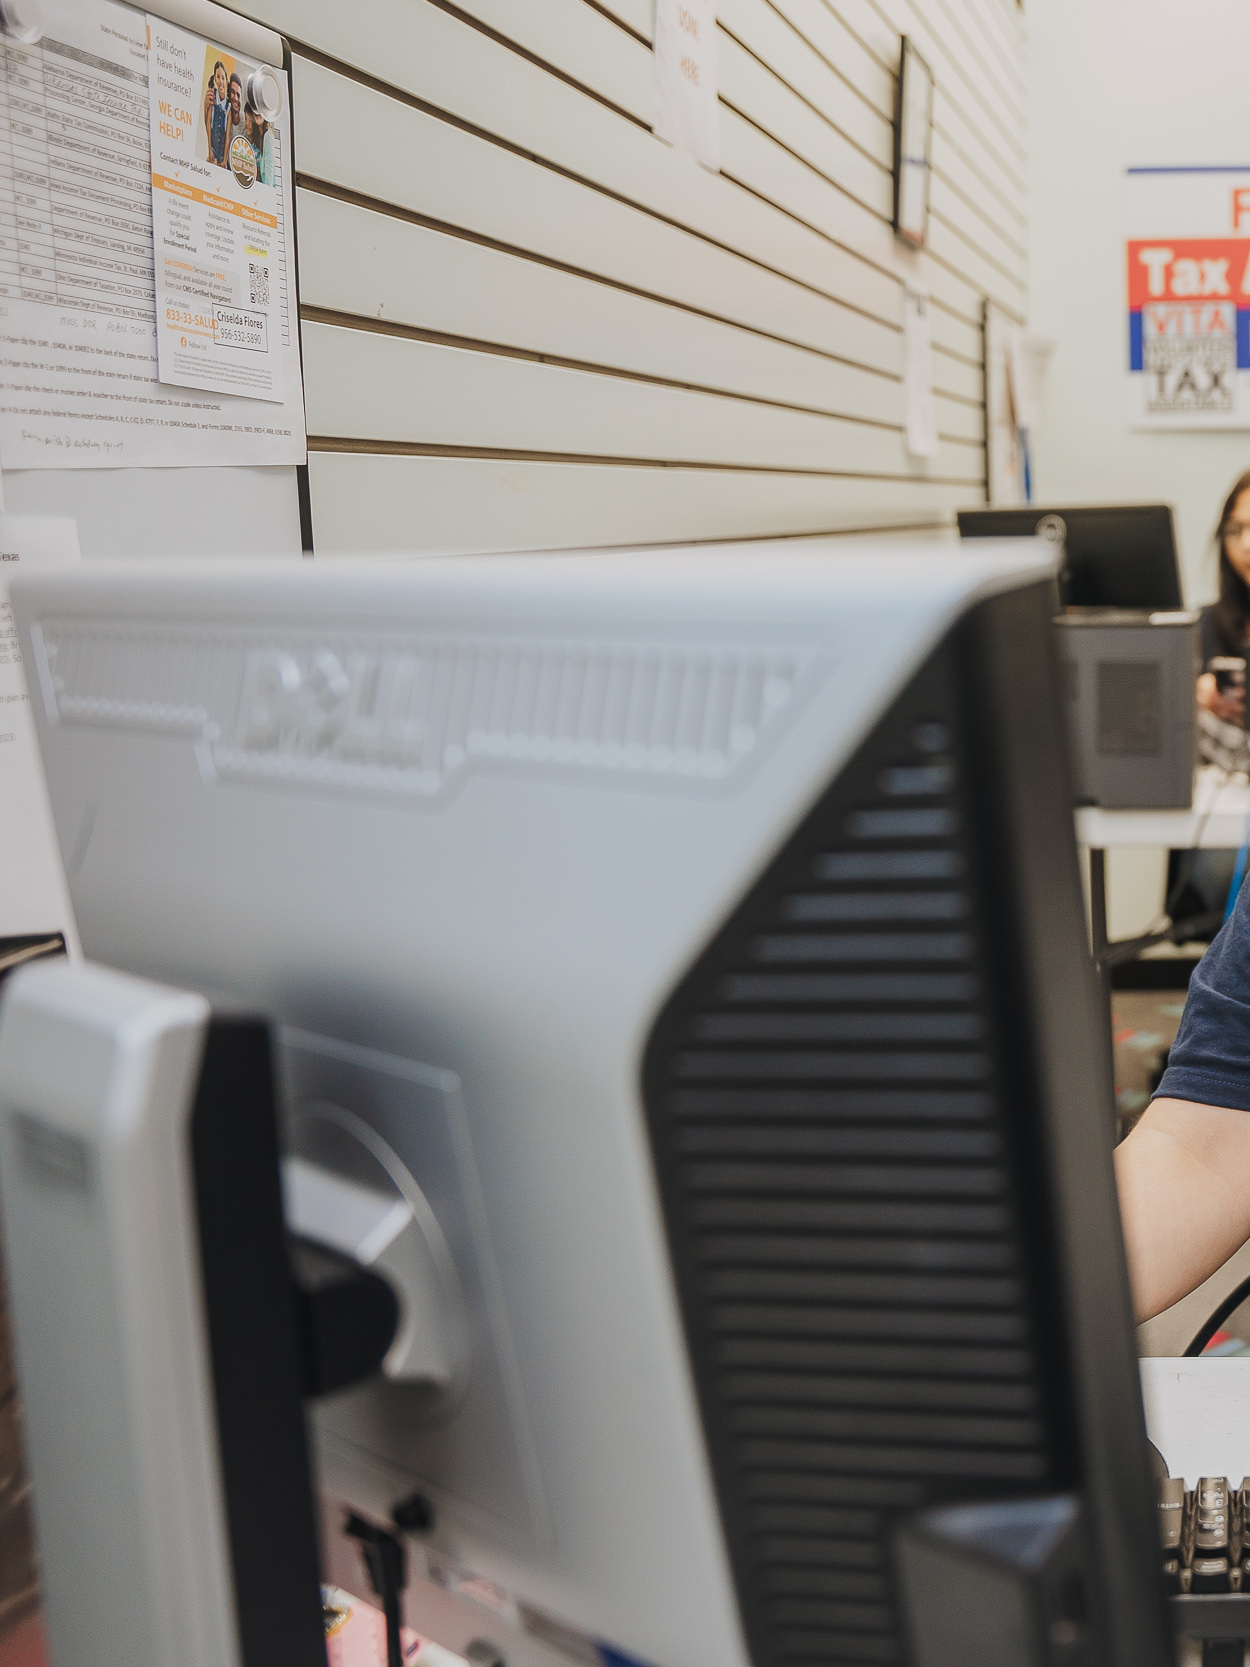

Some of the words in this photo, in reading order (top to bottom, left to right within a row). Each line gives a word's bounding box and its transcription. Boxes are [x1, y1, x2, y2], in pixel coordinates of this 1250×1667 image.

[156, 36, 168, 52] Still
[170, 43, 186, 60] don't
[157, 54, 172, 71] have
[174, 63, 194, 81] health
[158, 73, 192, 98] insurance?
[158, 100, 172, 118] WE
[174, 108, 192, 126] CAN
[159, 120, 184, 142] HELP!
[160, 152, 178, 165] Contact
[164, 180, 192, 197] Marketplace
[203, 193, 234, 211] Medicaid/CHIP
[242, 207, 254, 218] Other
[254, 212, 270, 224] Services
[164, 238, 184, 249] Enrollment
[176, 231, 190, 241] Special
[1139, 248, 1230, 296] Tax
[192, 288, 209, 298] Certified
[166, 308, 219, 330] 833-33-SALUD
[217, 310, 242, 326] Criselda
[244, 316, 263, 330] Flores
[1145, 307, 1230, 335] VITA
[220, 328, 262, 344] 956-532-5890
[1150, 364, 1231, 397] TAX
